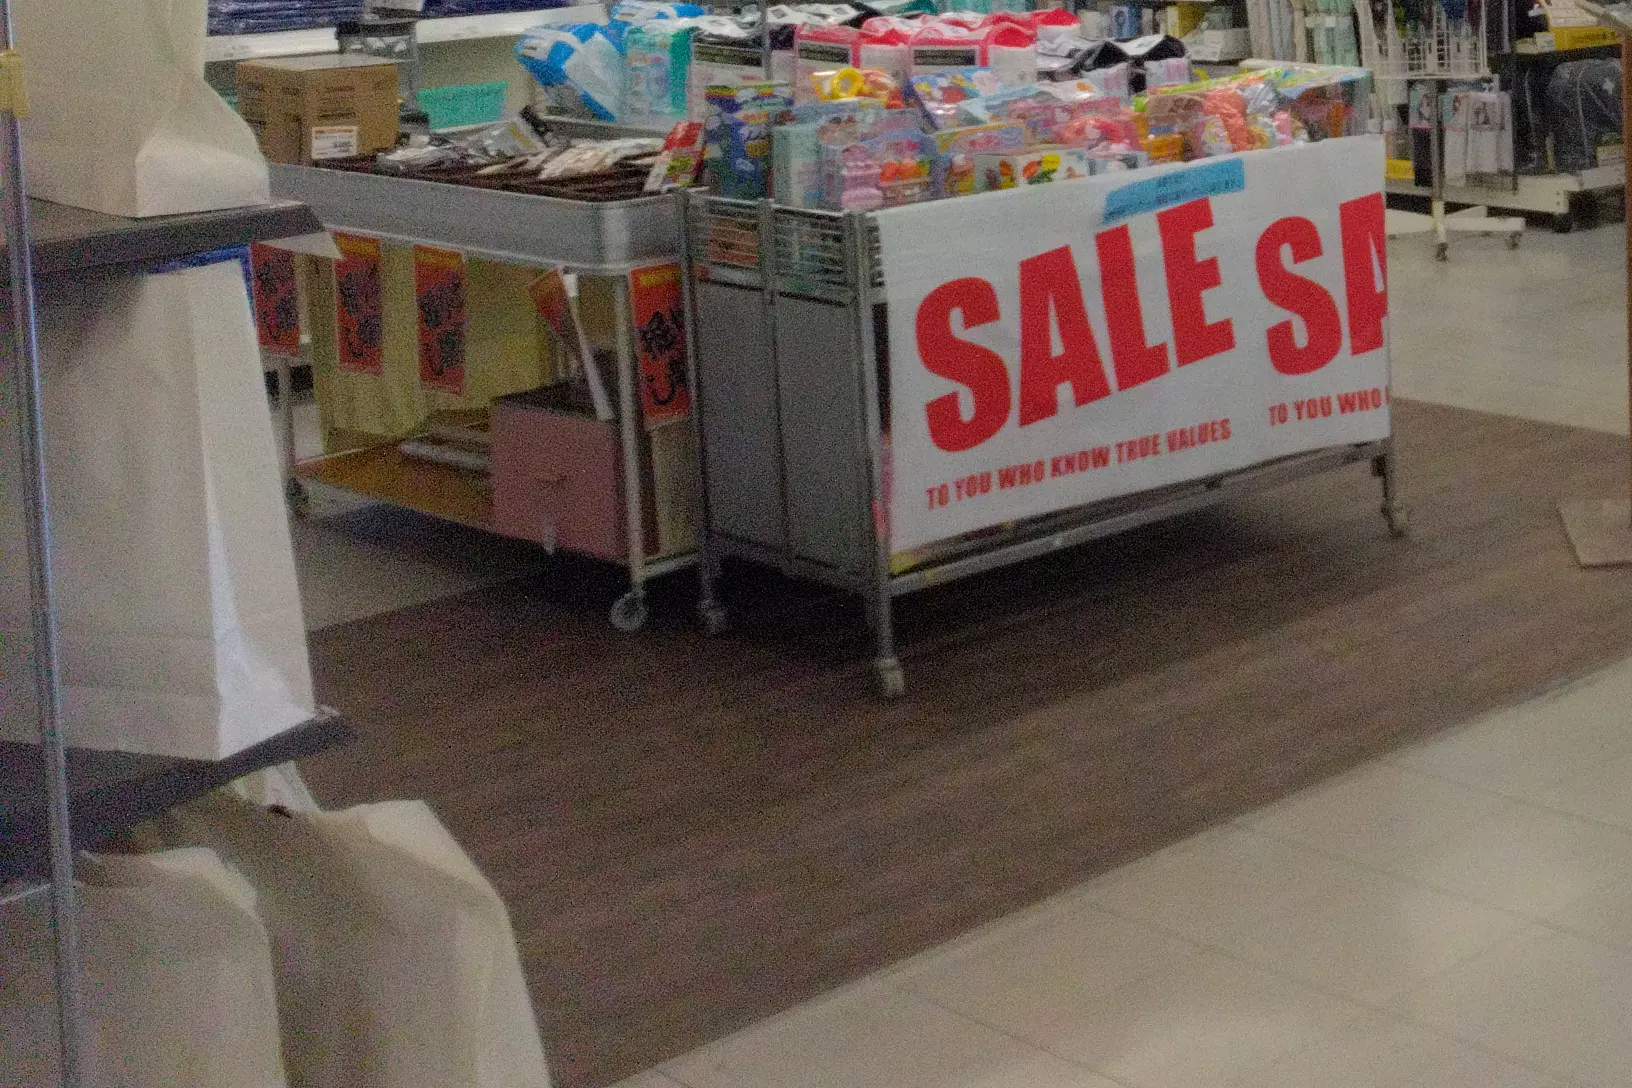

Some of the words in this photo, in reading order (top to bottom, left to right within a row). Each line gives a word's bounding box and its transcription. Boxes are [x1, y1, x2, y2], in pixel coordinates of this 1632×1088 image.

[915, 196, 1237, 454] SALE
[1268, 402, 1289, 427] TO
[1294, 395, 1333, 421] YOU
[1337, 387, 1382, 415] WHO
[926, 483, 950, 510] TO
[954, 471, 992, 501] YOU
[998, 460, 1046, 490] WHO
[1050, 445, 1111, 478] KNOW
[1115, 433, 1161, 465] TRUE
[1166, 418, 1233, 453] VALUES
